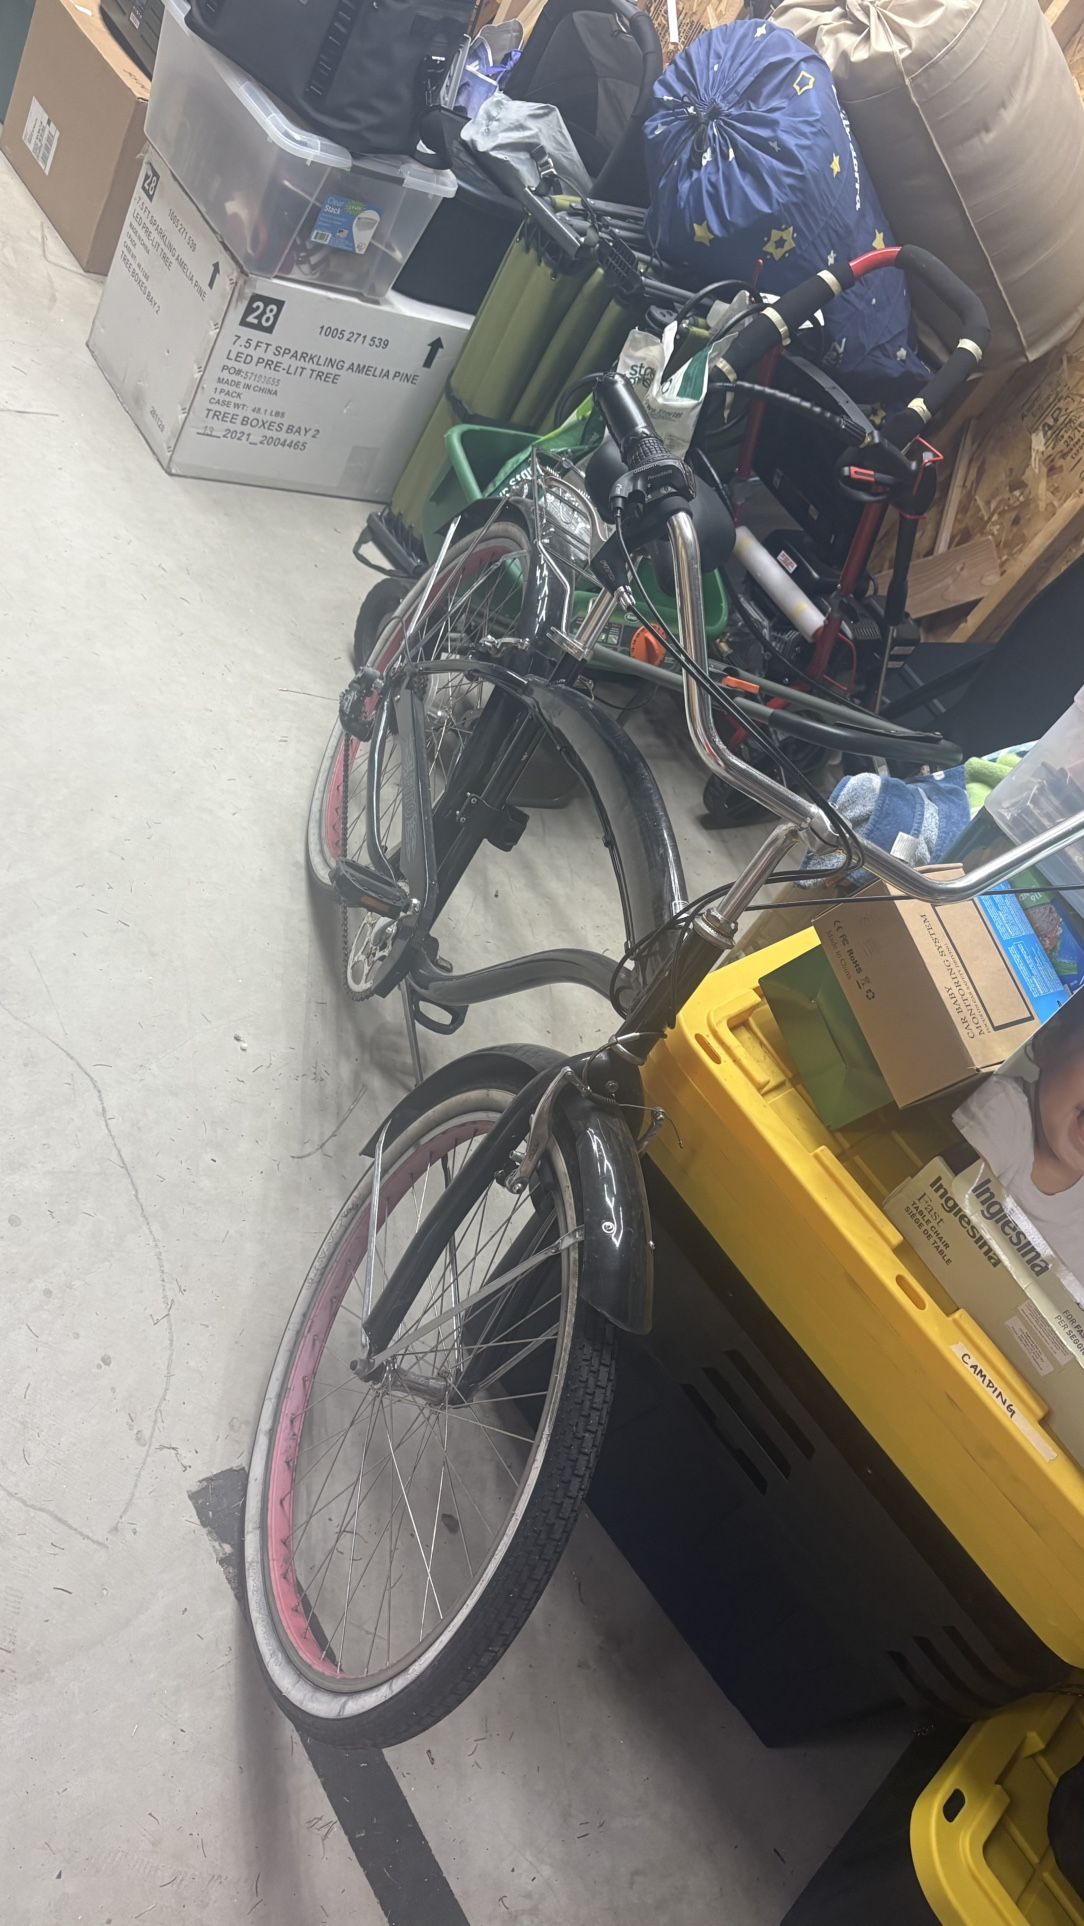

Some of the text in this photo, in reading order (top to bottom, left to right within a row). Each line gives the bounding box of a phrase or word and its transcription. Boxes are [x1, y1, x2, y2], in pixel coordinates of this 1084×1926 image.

[144, 171, 157, 194] 28
[132, 209, 173, 271] LED PRE-LIT TREE
[168, 209, 180, 229] 1005
[179, 224, 188, 240] 271
[144, 206, 150, 220] FT
[150, 215, 177, 257] SPARKLING
[175, 255, 194, 284] AMELIA
[194, 280, 208, 302] PINE
[120, 250, 160, 314] TREE BOXES BAY 2
[246, 301, 278, 327] 28
[318, 325, 390, 350] 1005 271 539
[226, 349, 341, 385] LED PRE-LIT TREE
[232, 335, 420, 386] 7.5 FT SPARKLING AMELIA PINE
[216, 377, 278, 396] MADE IN CHINA
[219, 388, 243, 400] PACK
[205, 408, 320, 438] TREE BOXES BAY 2
[209, 397, 232, 408] CASE
[234, 402, 248, 412] WT:
[270, 410, 286, 419] LBS
[847, 948, 862, 974] RoHS
[920, 914, 985, 1036] MONITORING SYSTEM
[944, 986, 974, 1039] CAR BABY
[912, 1201, 950, 1250] TABLE CHAIR
[918, 1192, 944, 1226] Fast
[930, 1176, 1000, 1268] Inglesina
[972, 1178, 1050, 1277] Inglesina
[923, 1229, 933, 1240] DE
[932, 1240, 952, 1266] TABLE
[1054, 1314, 1068, 1330] PER
[1062, 1310, 1076, 1326] FOR
[962, 1353, 1016, 1418] CAMPING
